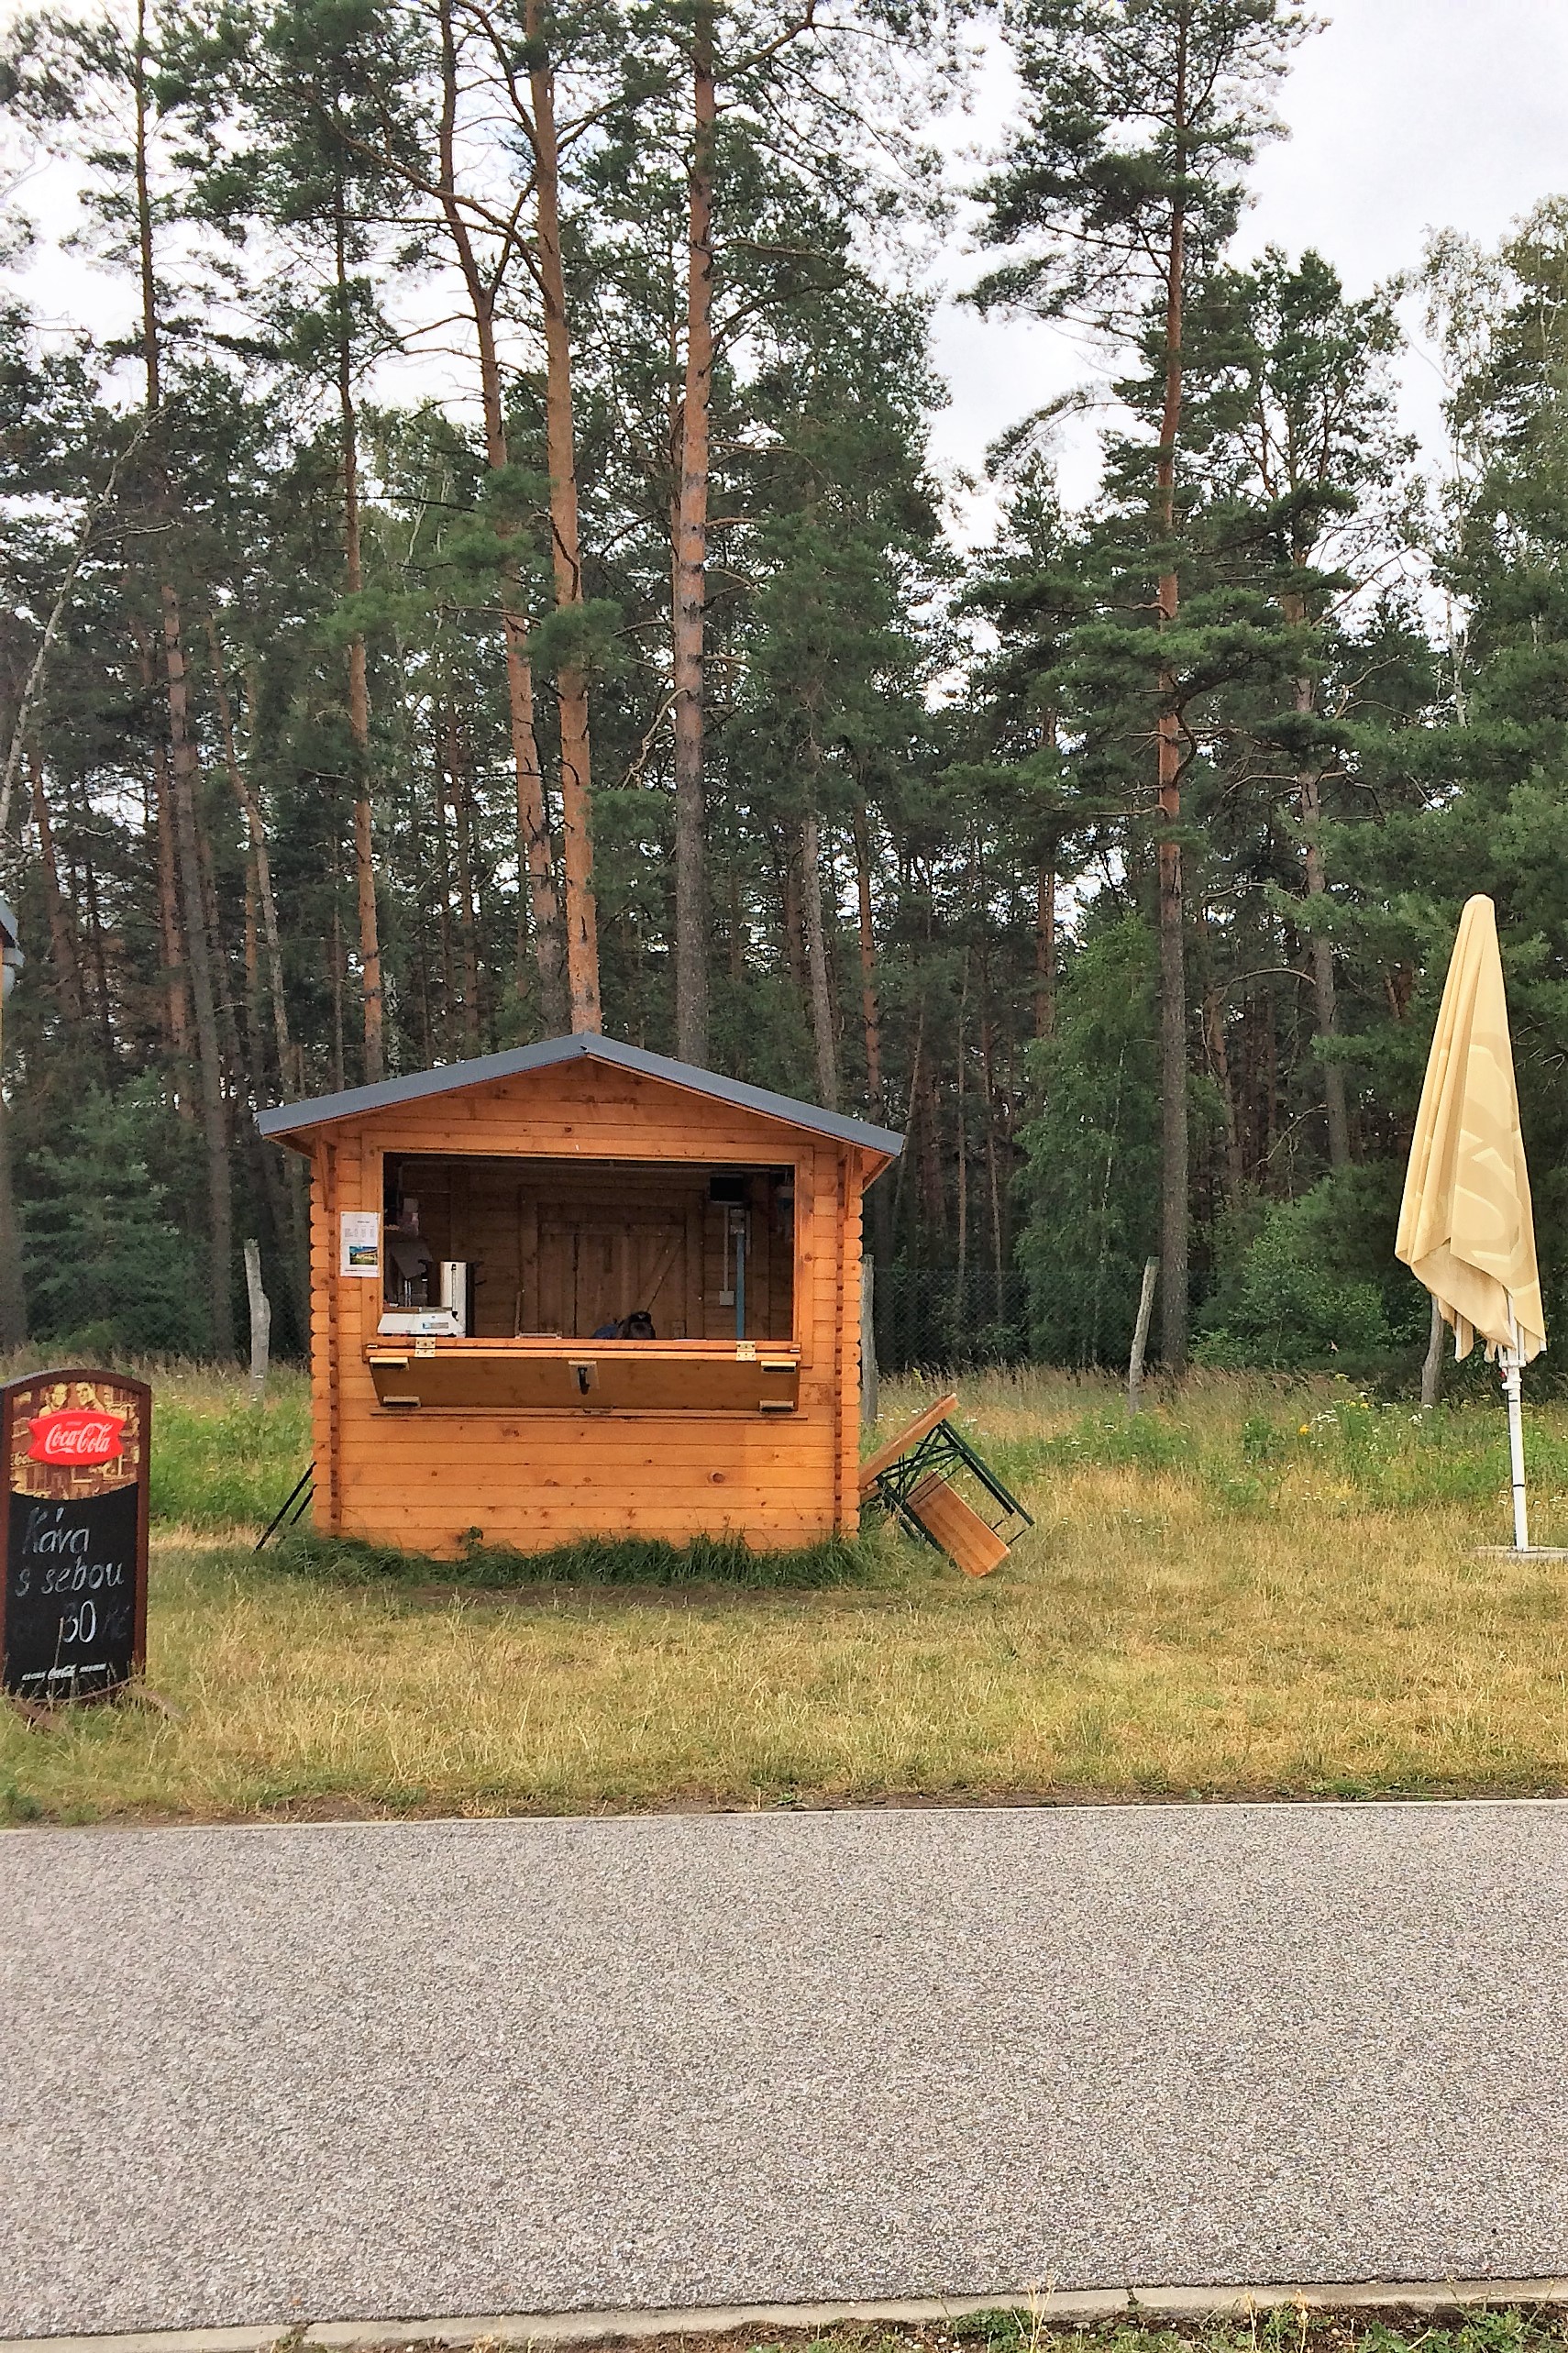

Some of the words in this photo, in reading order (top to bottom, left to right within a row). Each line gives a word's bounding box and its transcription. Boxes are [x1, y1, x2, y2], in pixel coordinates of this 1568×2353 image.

[45, 1422, 114, 1455] Coca-Cola
[22, 1507, 90, 1555] Káva
[41, 1555, 125, 1595] sebou
